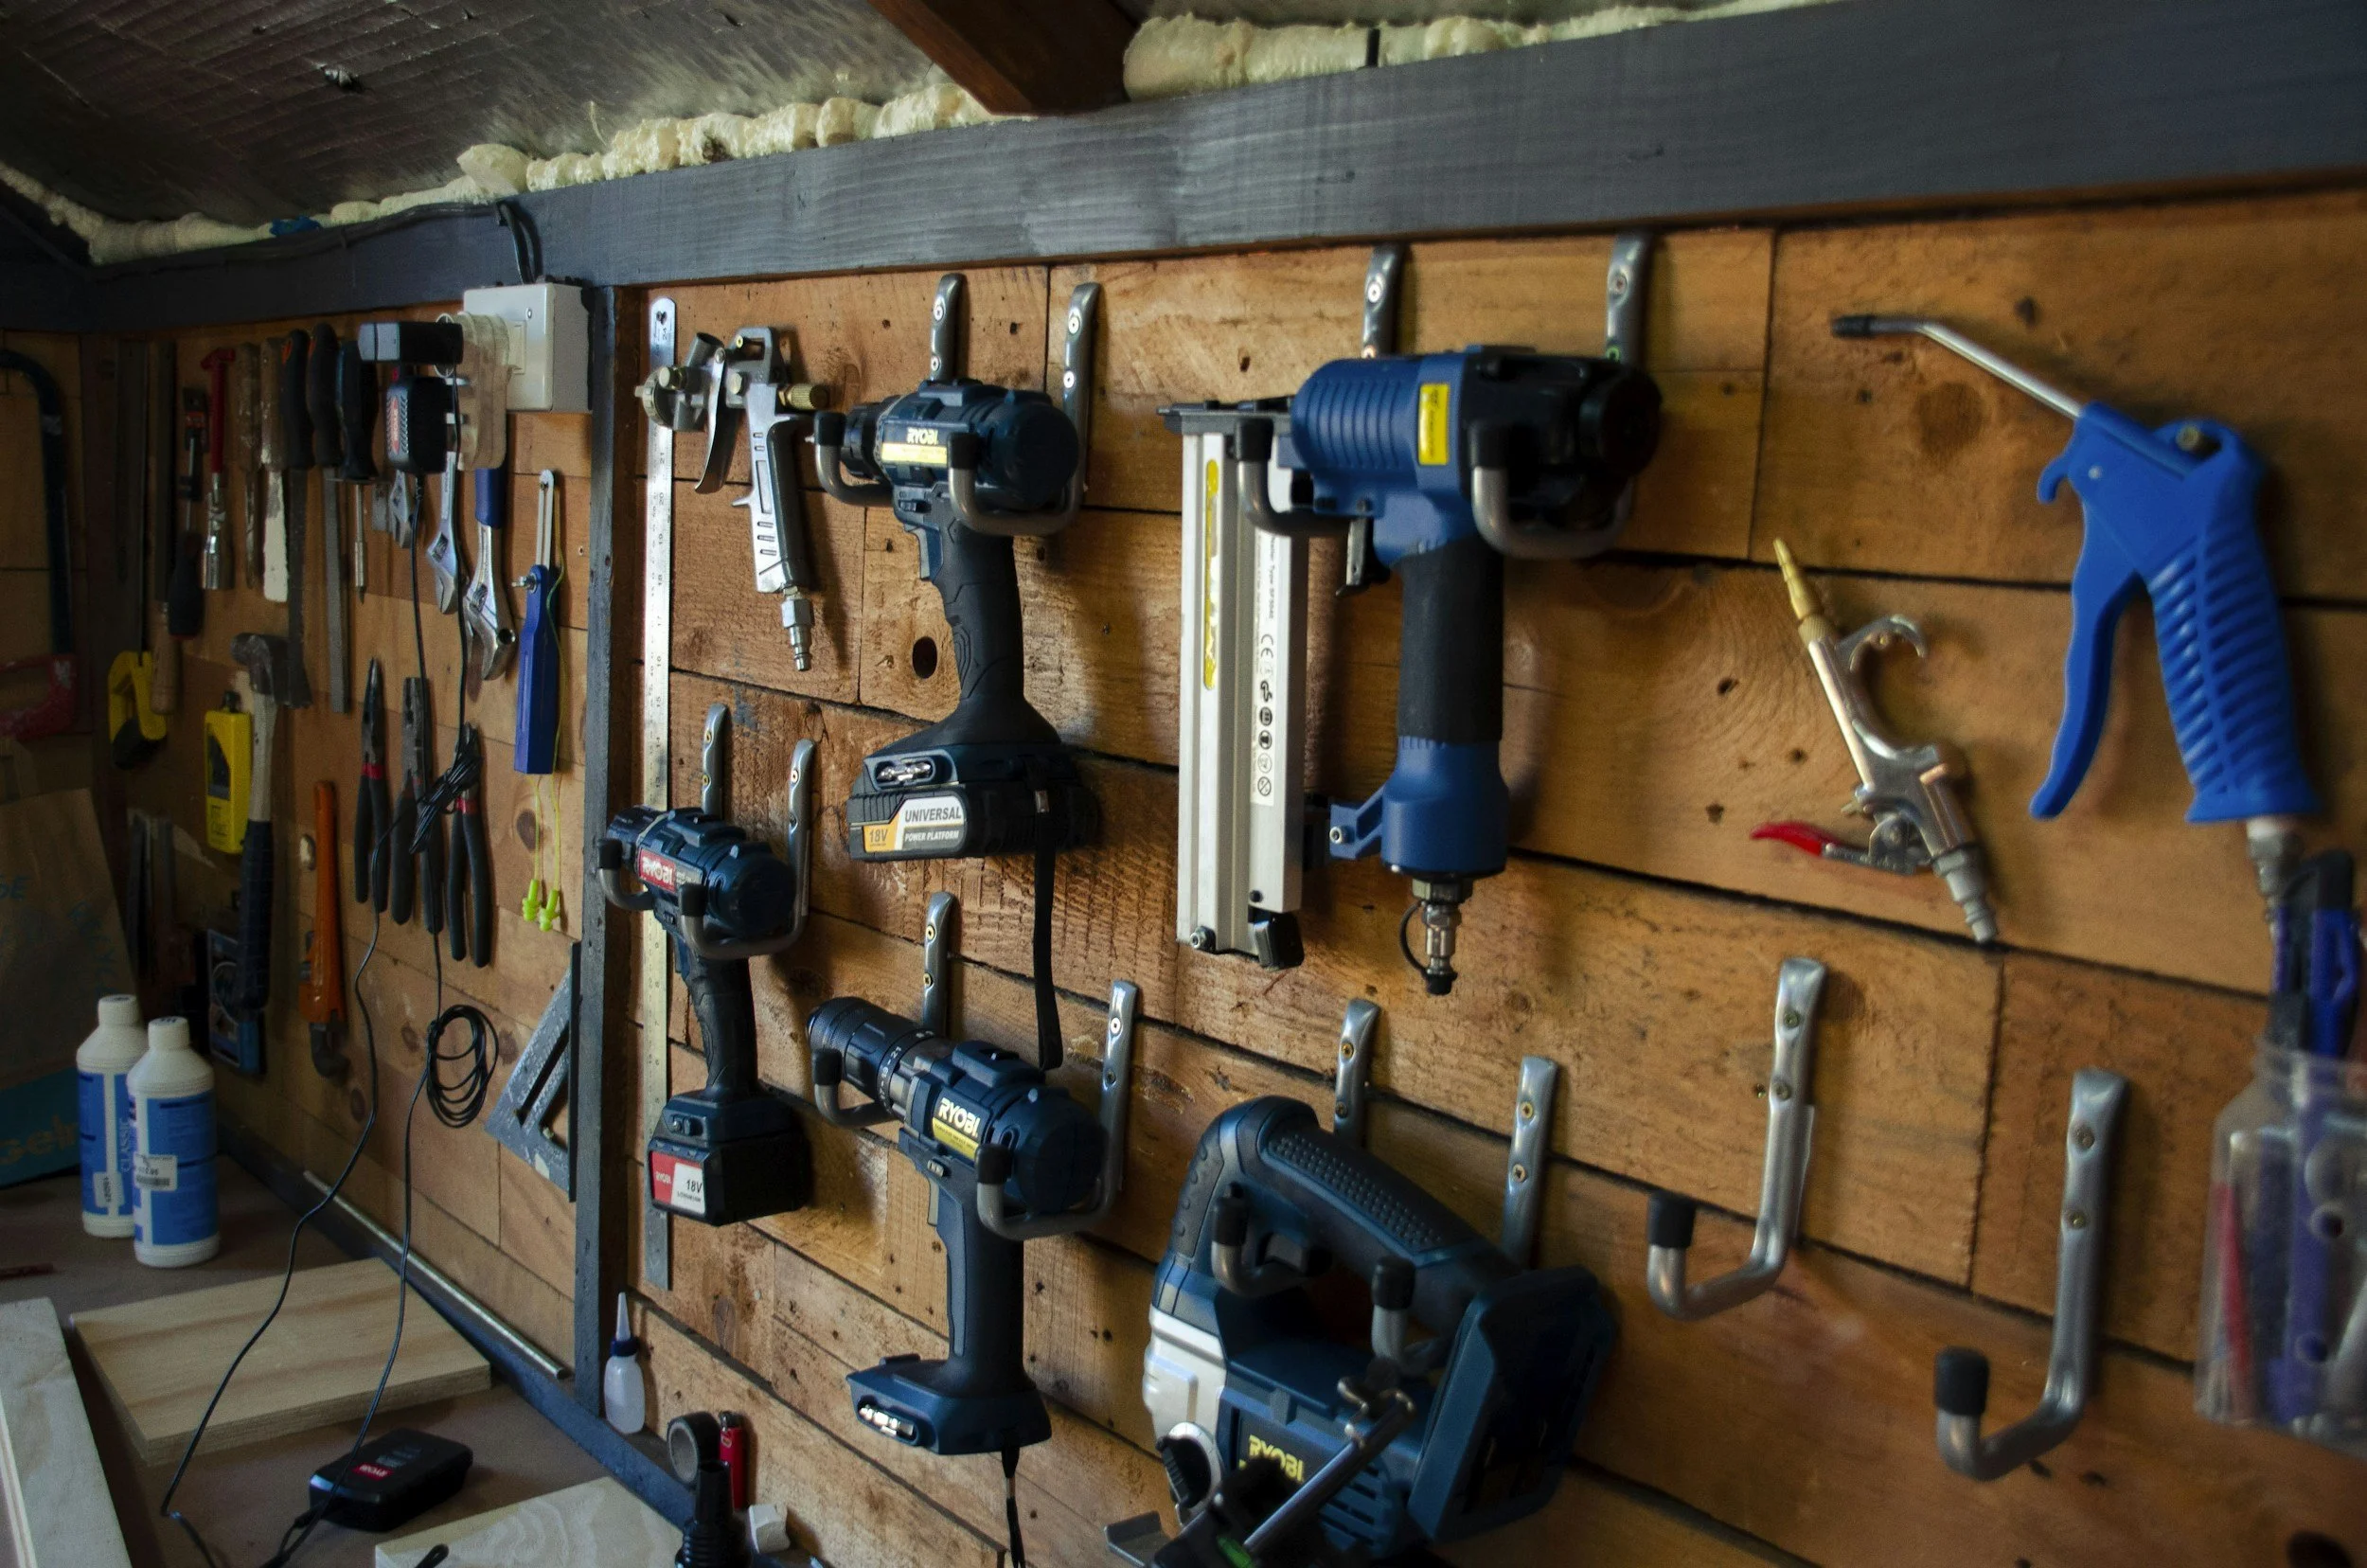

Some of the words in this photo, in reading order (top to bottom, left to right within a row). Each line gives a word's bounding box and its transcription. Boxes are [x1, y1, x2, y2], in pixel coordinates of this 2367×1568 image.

[906, 426, 940, 446] RYOBI
[904, 807, 962, 823] UNIVERSAL
[869, 829, 888, 843] 18V
[904, 832, 927, 842] POWER
[927, 830, 960, 841] PLATFORM
[642, 856, 674, 885] RYOBI
[881, 1066, 889, 1078] 19
[890, 1045, 902, 1059] 21
[938, 1097, 981, 1138] RYOBI
[686, 1178, 703, 1193] 18V
